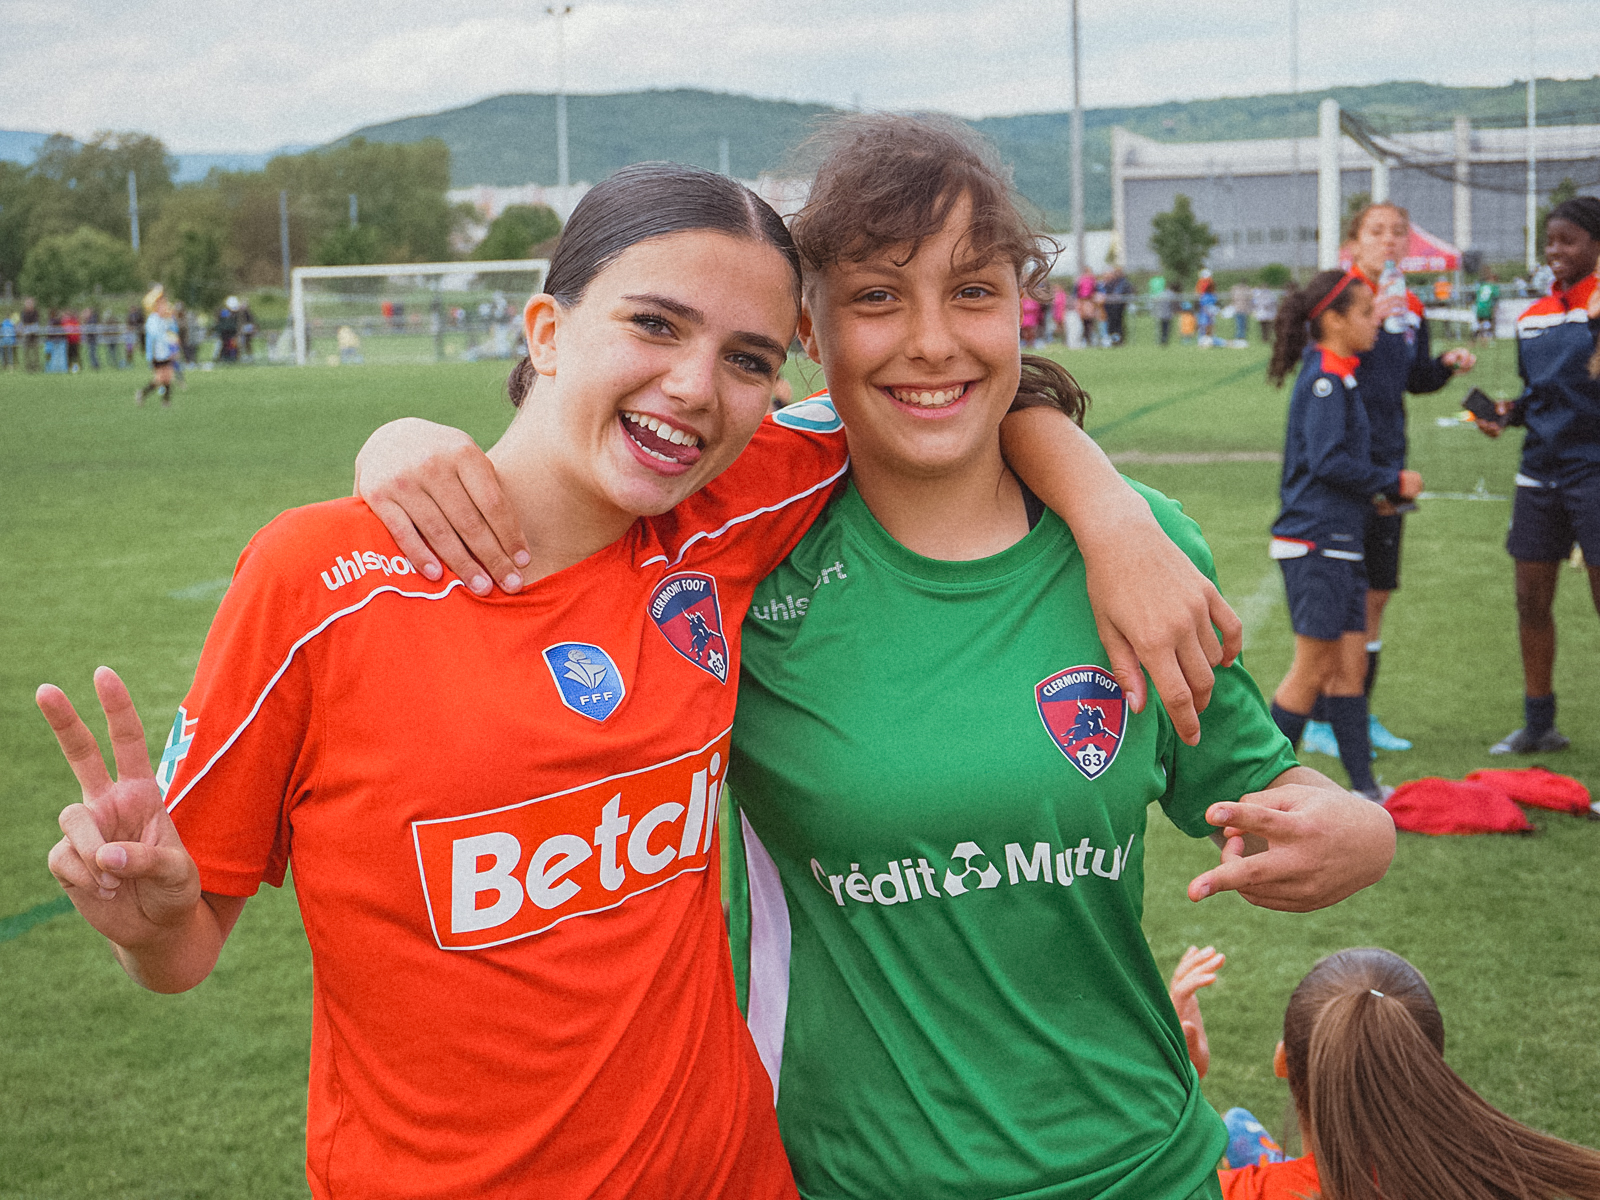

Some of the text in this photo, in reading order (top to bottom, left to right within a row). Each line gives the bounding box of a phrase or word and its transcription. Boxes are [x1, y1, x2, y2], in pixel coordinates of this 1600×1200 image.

[651, 579, 707, 619] CLERMONT FOOT
[712, 658, 724, 673] 63
[1042, 672, 1119, 697] CLERMONT FOOT
[579, 692, 613, 706] FFF
[1082, 753, 1102, 767] 63
